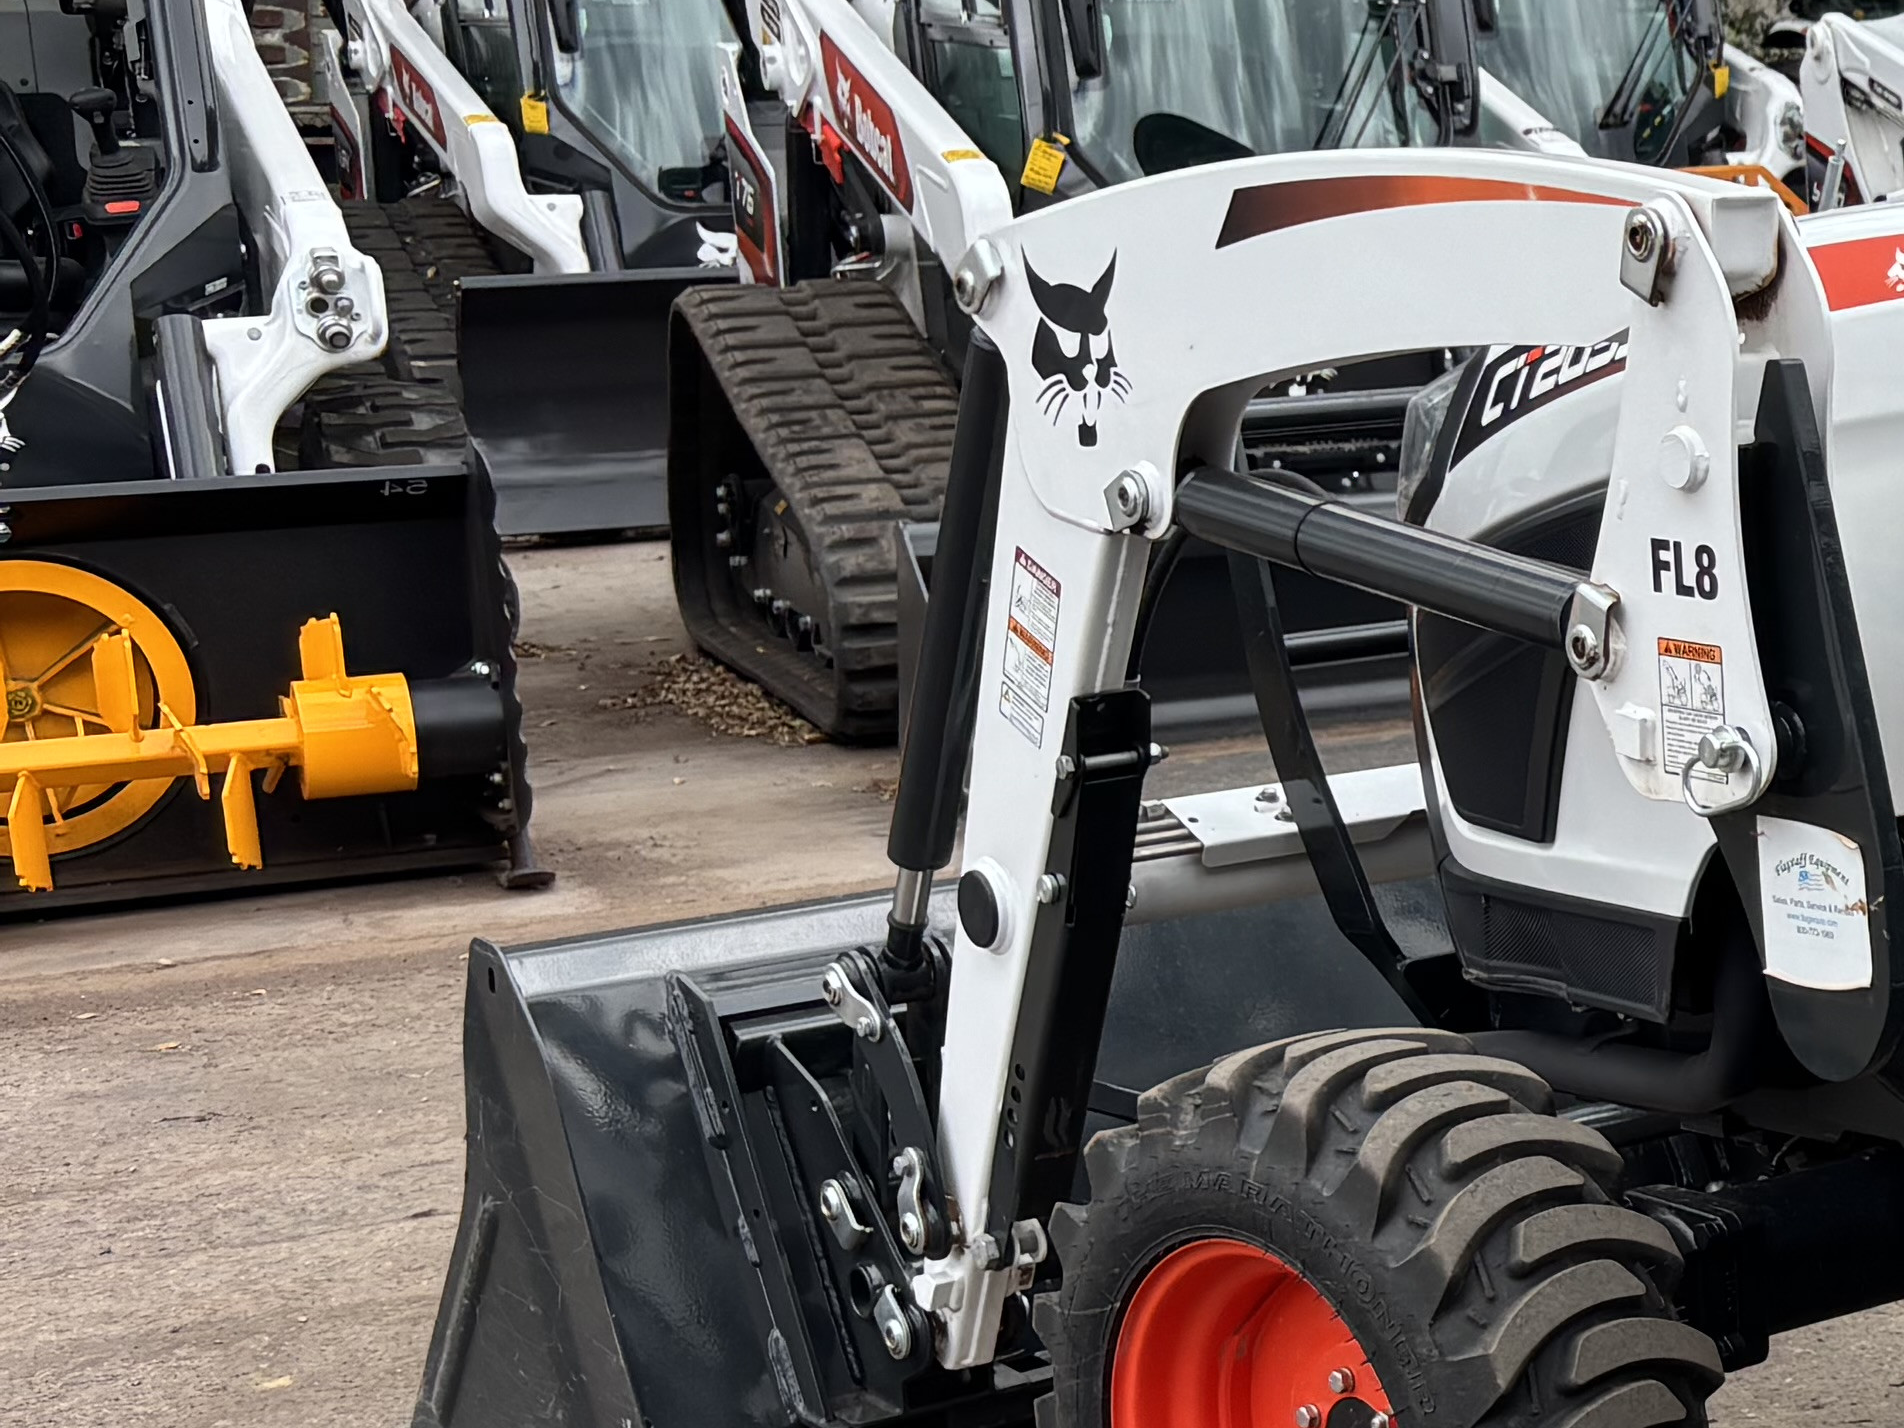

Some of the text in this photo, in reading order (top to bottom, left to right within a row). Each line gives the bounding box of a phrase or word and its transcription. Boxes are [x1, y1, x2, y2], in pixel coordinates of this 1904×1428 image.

[853, 93, 896, 183] Bobcat
[1650, 537, 1719, 601] FL8
[1673, 642, 1716, 661] WARNING
